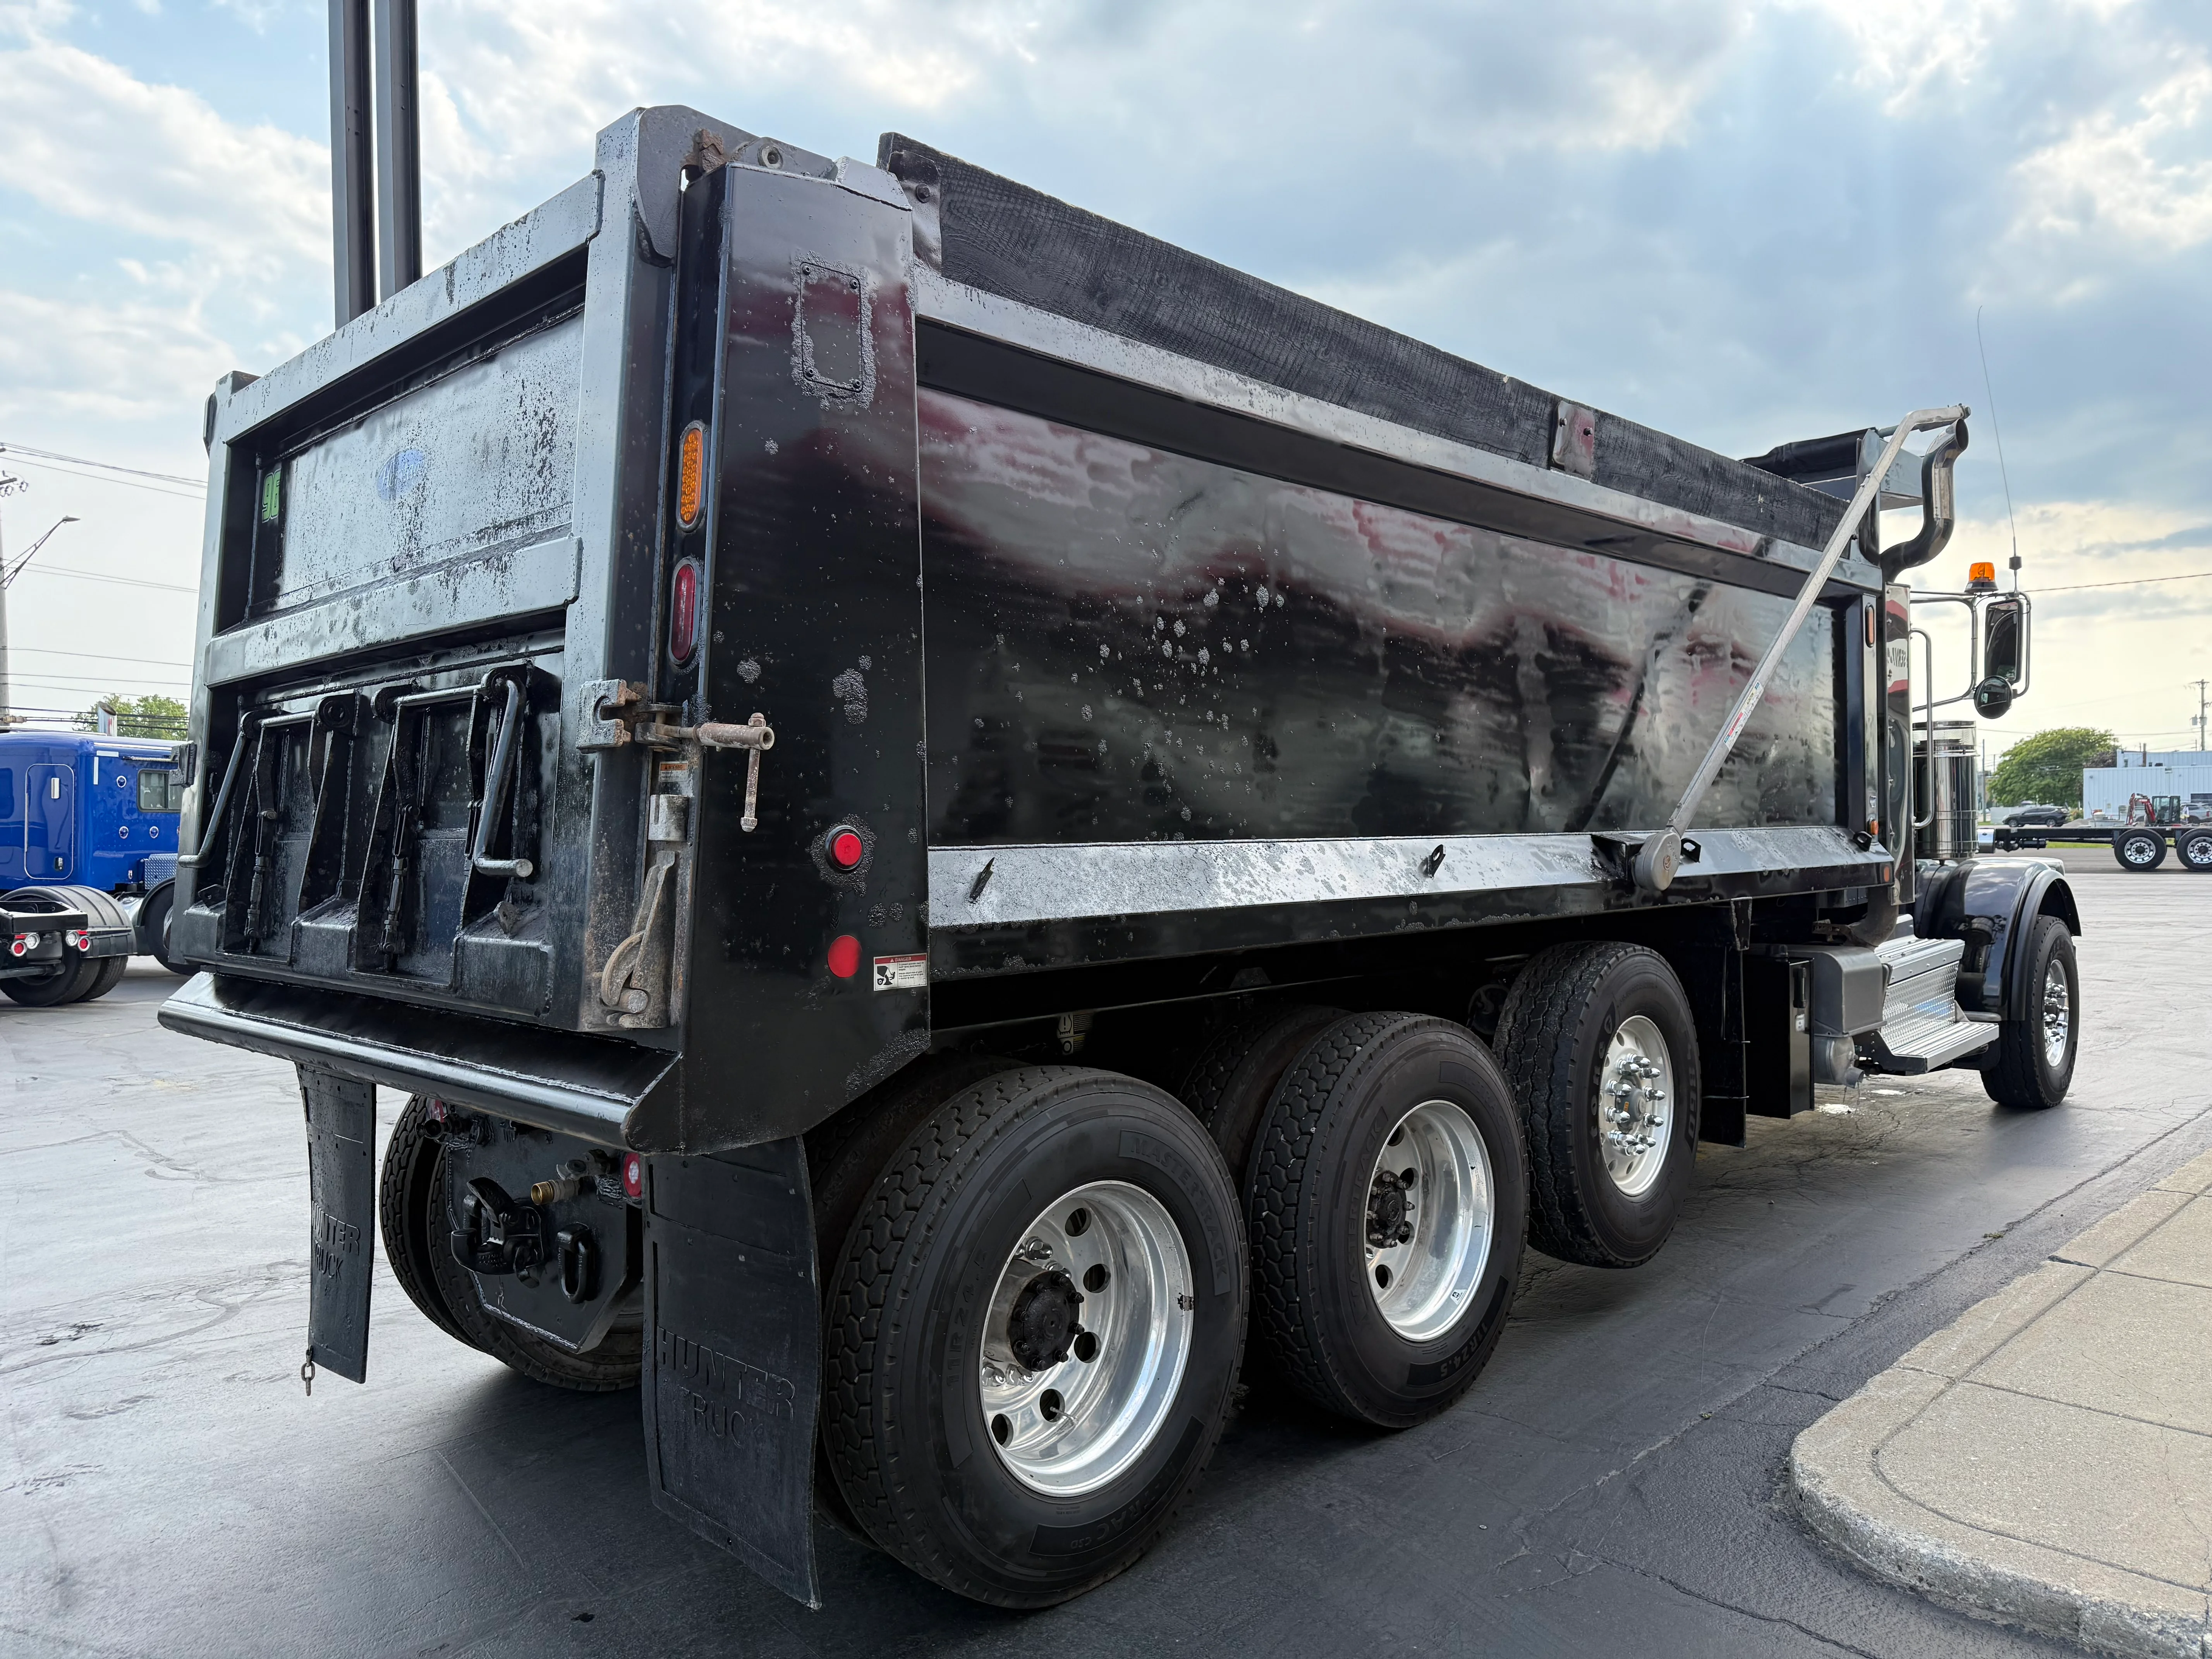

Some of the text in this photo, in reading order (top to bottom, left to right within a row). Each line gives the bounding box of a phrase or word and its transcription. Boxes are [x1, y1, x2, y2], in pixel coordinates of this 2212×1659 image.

[262, 468, 282, 523] 96
[312, 1200, 361, 1256] HUNTER
[1131, 1137, 1228, 1279] MASTERTRACK
[657, 1326, 795, 1424] HUNTER
[1440, 1322, 1488, 1379] 11R24.5
[678, 1385, 765, 1450] RUC
[1070, 1536, 1092, 1549] CSD
